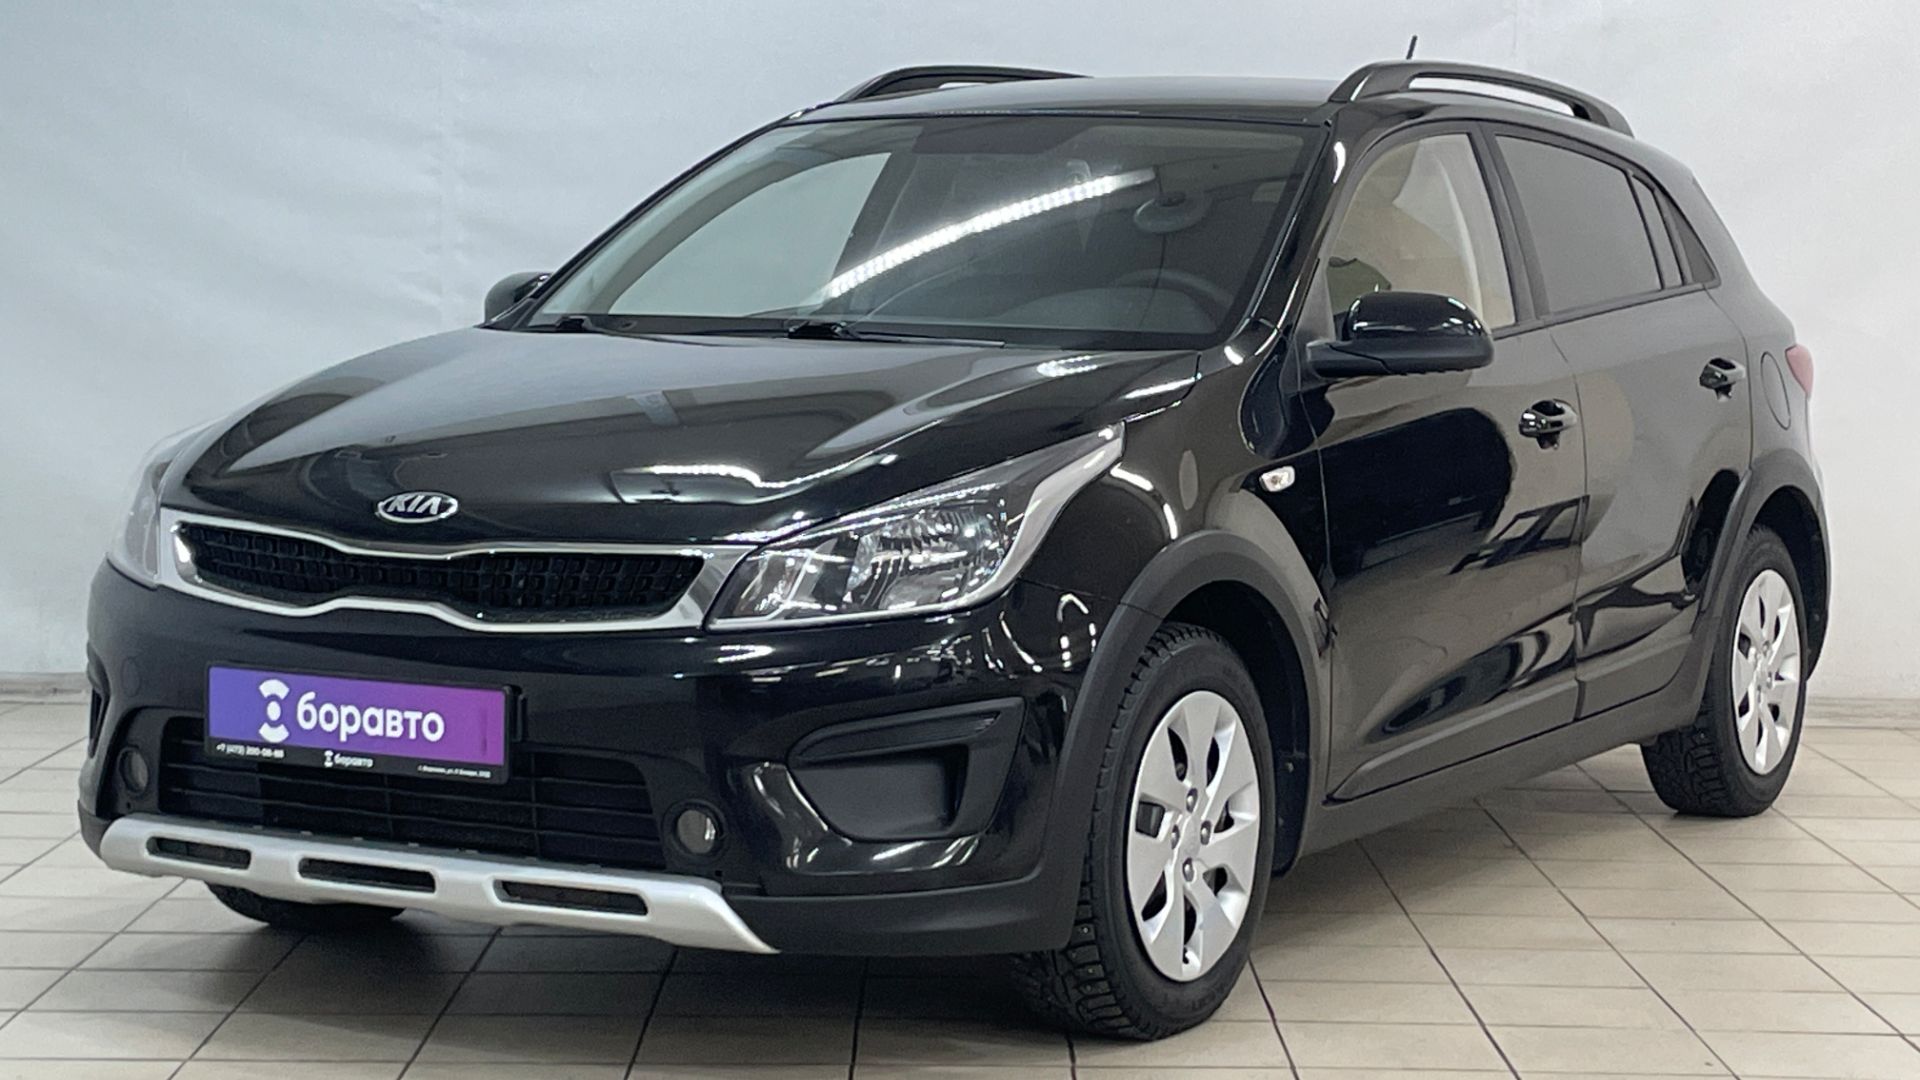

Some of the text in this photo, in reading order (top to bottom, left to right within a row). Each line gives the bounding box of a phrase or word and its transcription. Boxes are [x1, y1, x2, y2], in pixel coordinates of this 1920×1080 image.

[386, 494, 442, 515] KIA
[296, 691, 445, 742] боравто
[334, 752, 374, 768] боравто
